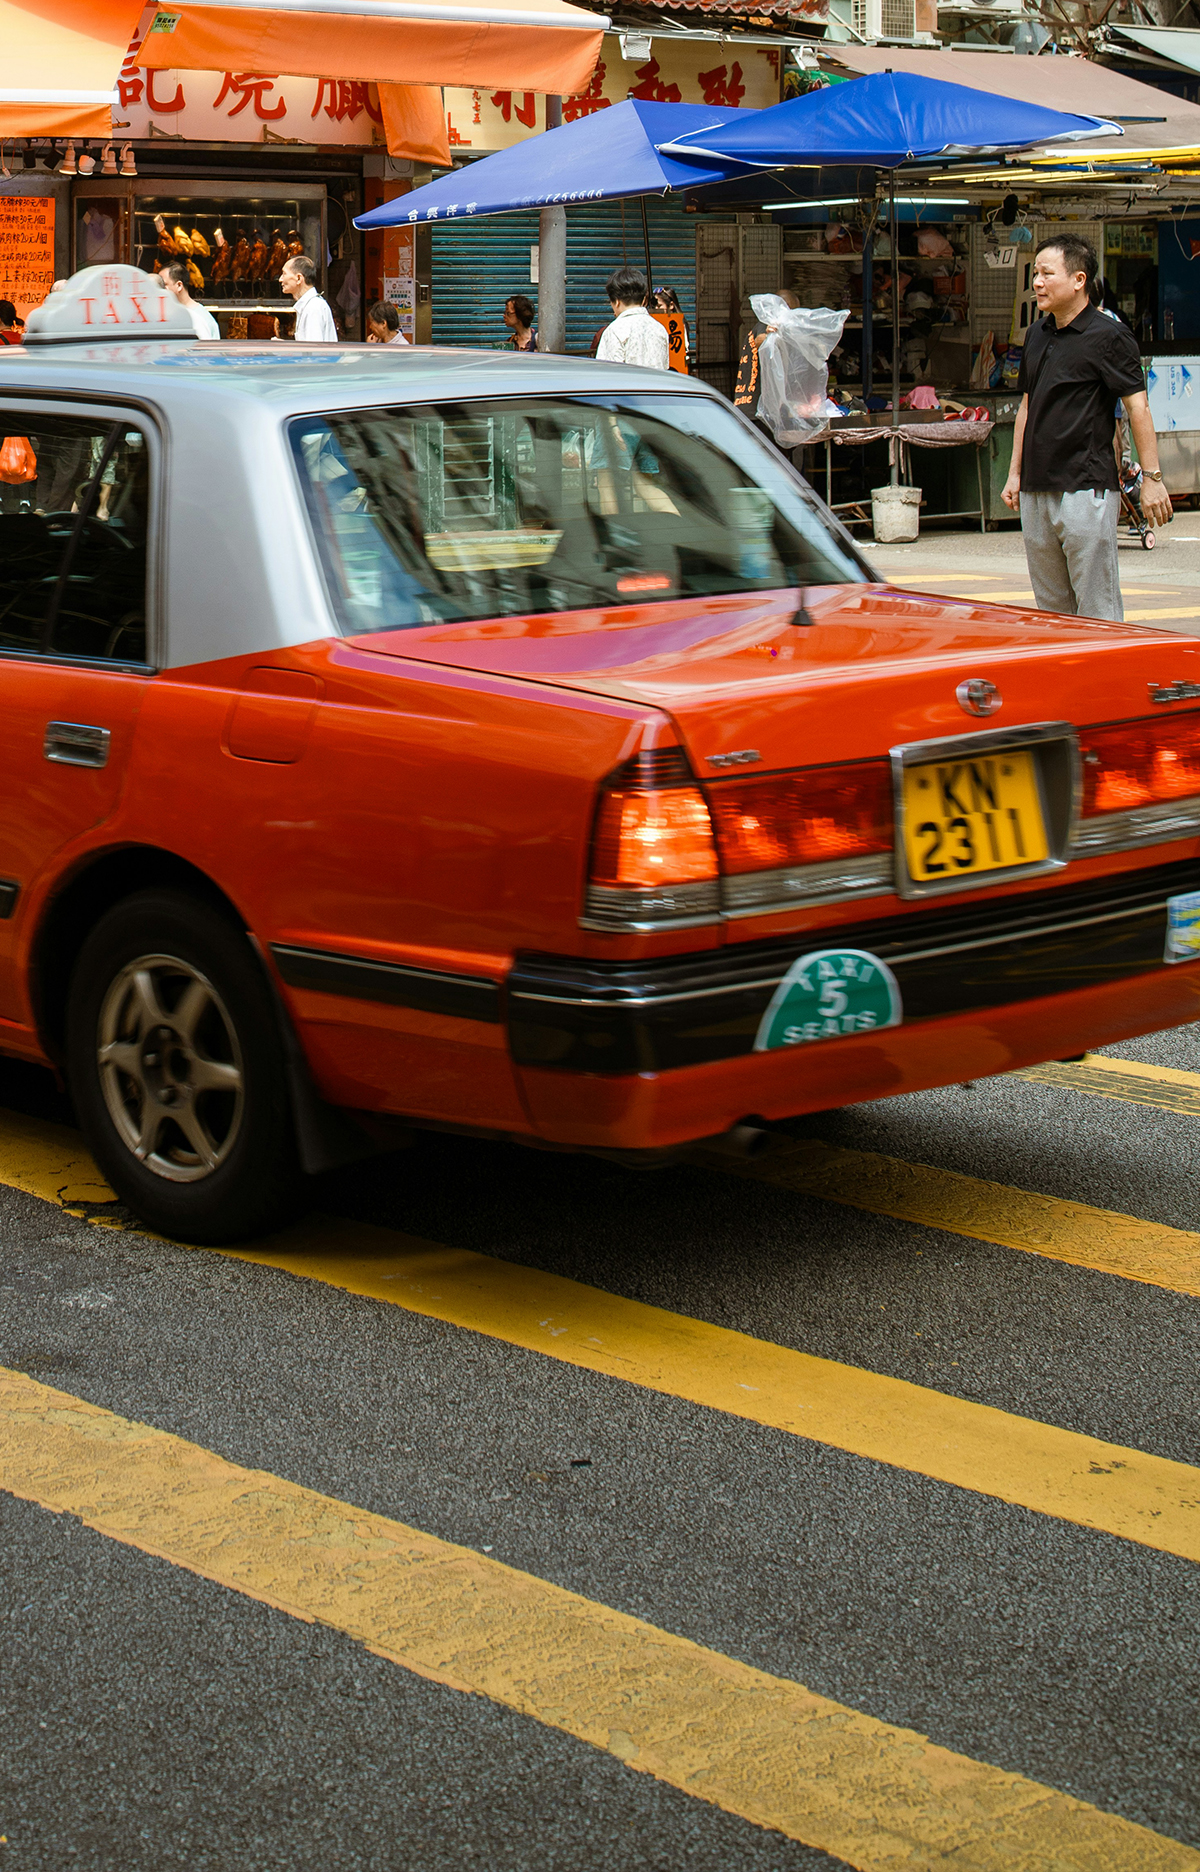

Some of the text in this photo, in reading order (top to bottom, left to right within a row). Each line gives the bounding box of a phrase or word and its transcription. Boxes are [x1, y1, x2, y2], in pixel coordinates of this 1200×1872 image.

[78, 296, 169, 325] TAXI
[935, 760, 999, 818] KN
[914, 808, 1027, 874] 2311
[797, 957, 875, 992] TAXI
[817, 979, 849, 1018] 5
[782, 1010, 878, 1044] SEATS
